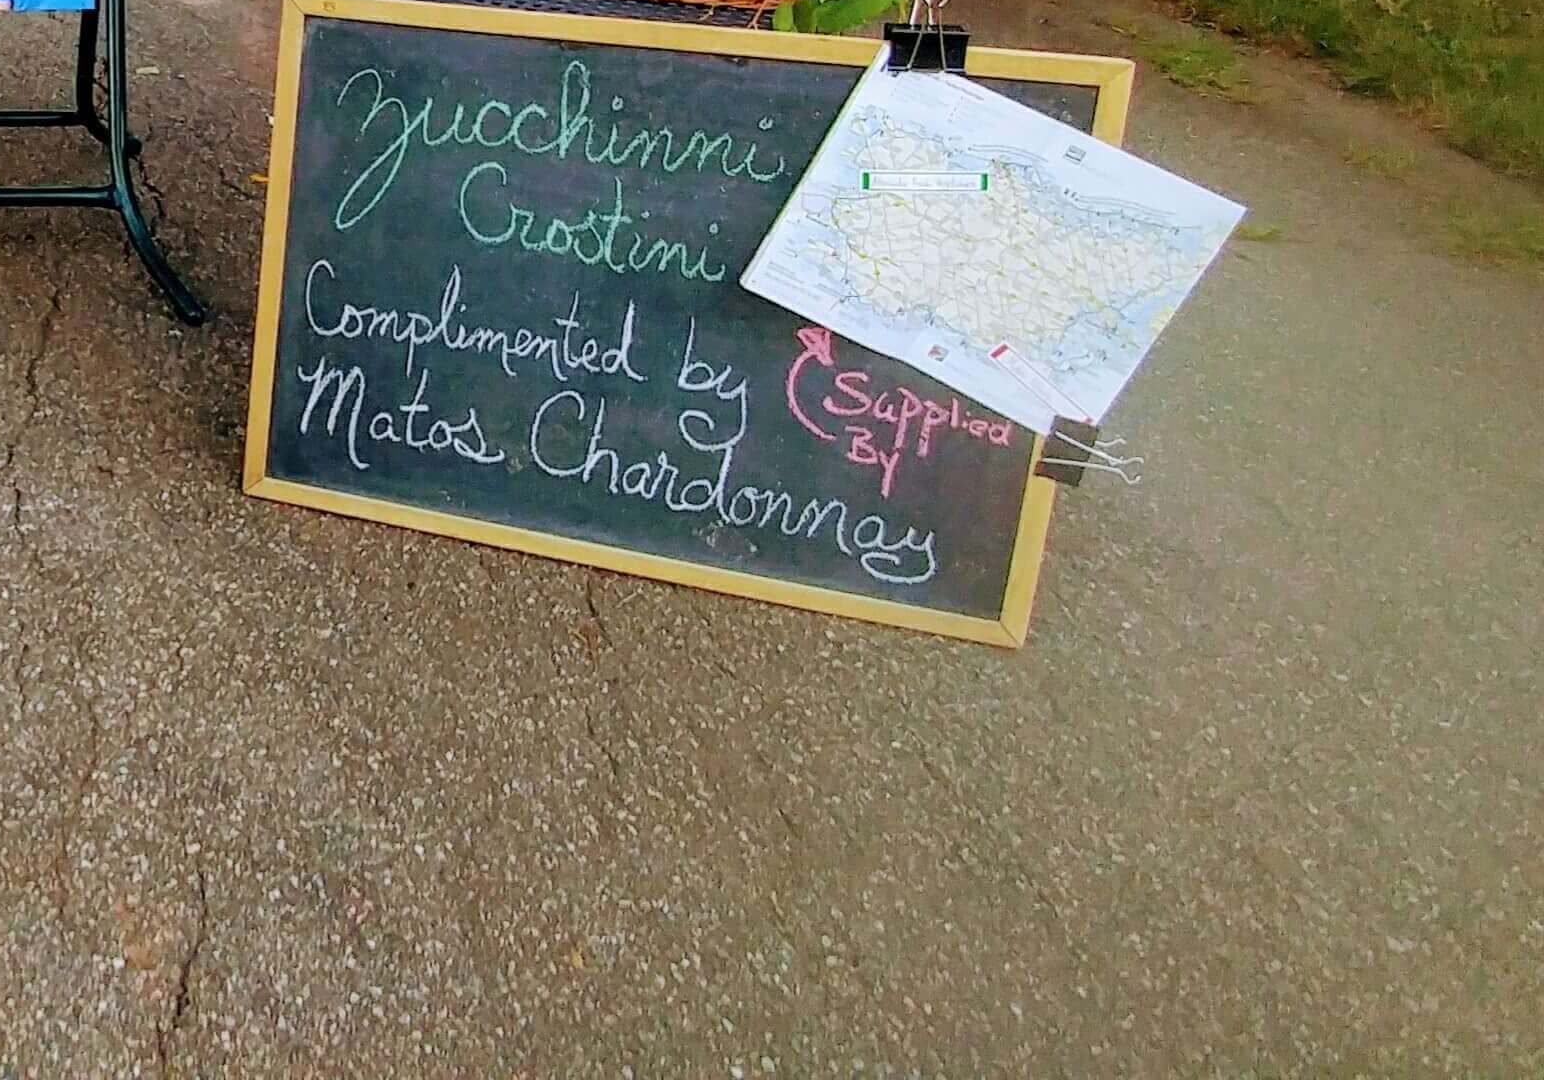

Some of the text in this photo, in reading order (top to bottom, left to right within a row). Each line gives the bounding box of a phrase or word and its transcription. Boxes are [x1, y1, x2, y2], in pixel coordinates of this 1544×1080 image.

[459, 161, 726, 282] Crostini
[305, 259, 748, 452] Complimented by
[823, 371, 1011, 458] Supplied
[297, 355, 936, 584] Matos Chardonnay
[845, 424, 901, 499] By
